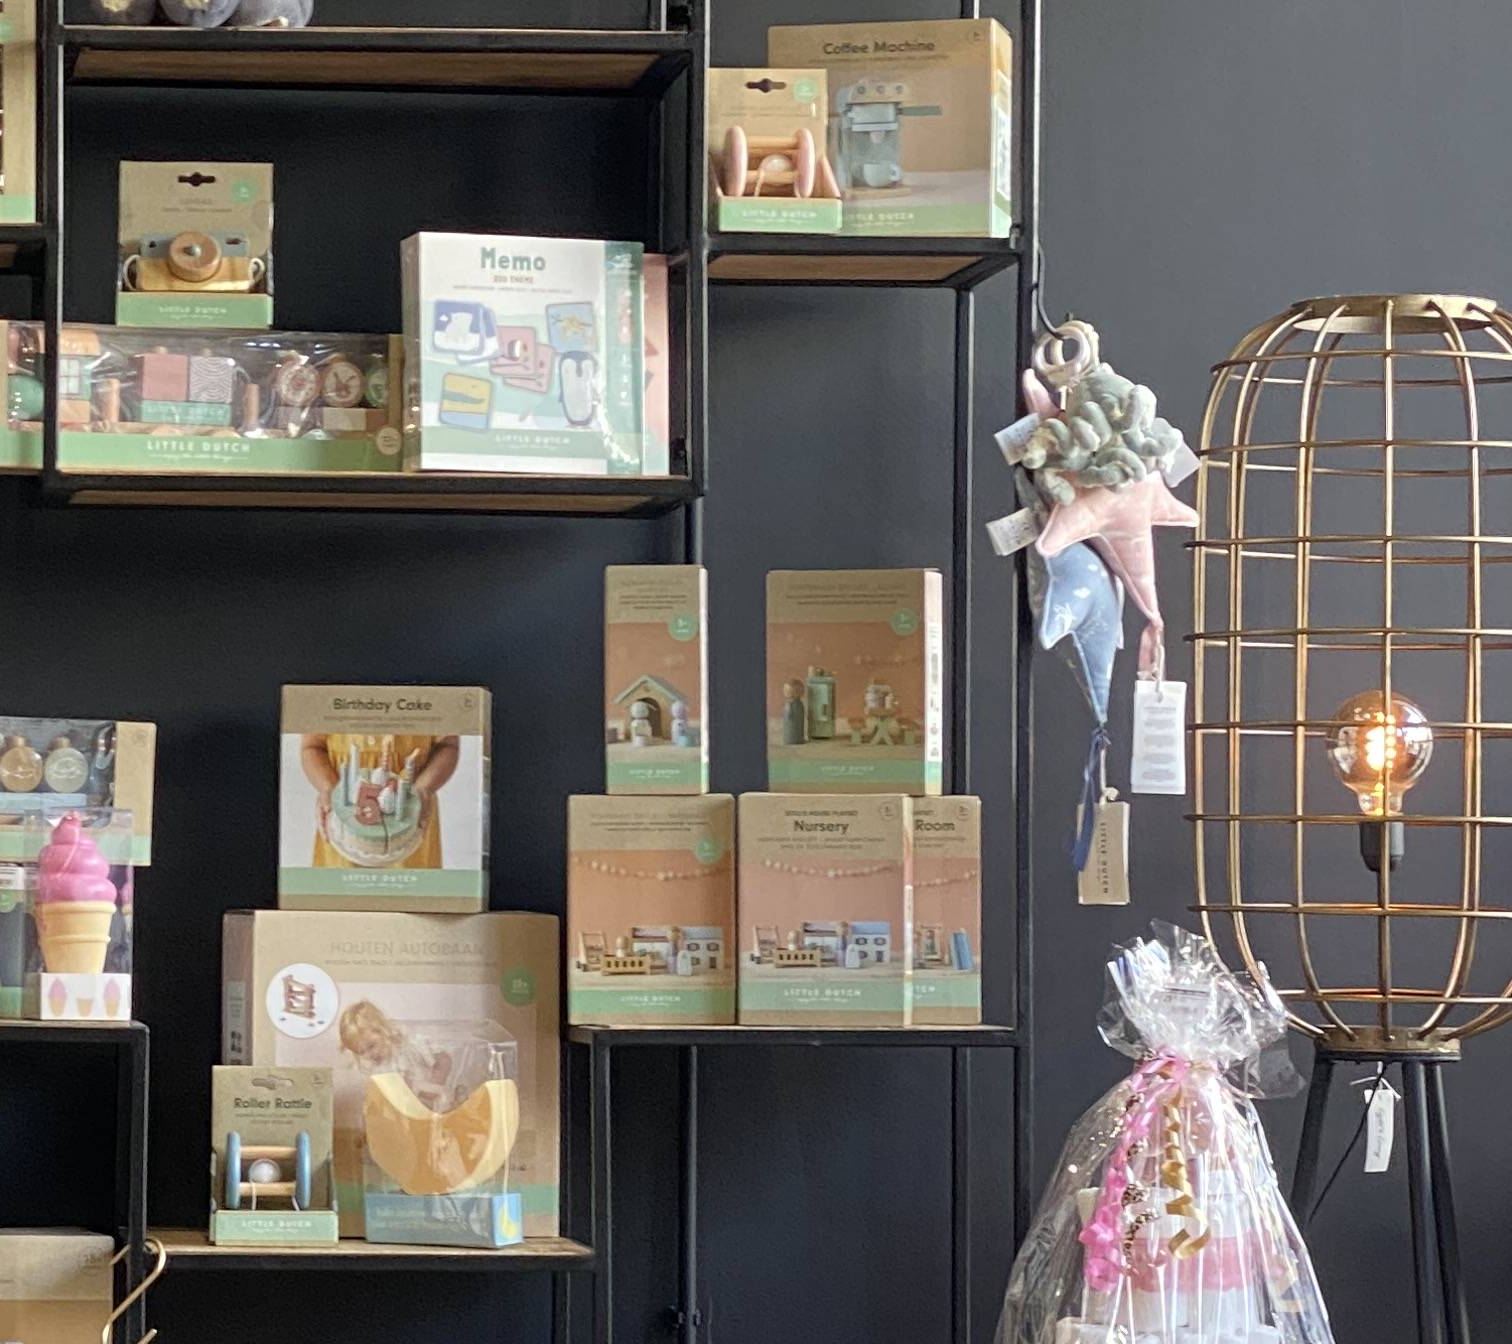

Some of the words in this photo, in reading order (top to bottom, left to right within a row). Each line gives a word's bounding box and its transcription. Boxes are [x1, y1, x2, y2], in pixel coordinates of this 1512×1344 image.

[823, 41, 869, 56] Coffee
[873, 39, 936, 54] Machine
[479, 247, 547, 272] Memo
[146, 440, 198, 453] LITTLE
[202, 440, 251, 454] DUTCH
[333, 698, 392, 714] Birthday
[395, 698, 433, 712] Cake
[793, 819, 850, 835] Nursery
[914, 819, 956, 833] Room
[330, 942, 393, 955] HOUTEN
[233, 1097, 271, 1109] Roller
[274, 1097, 313, 1109] Rattle
